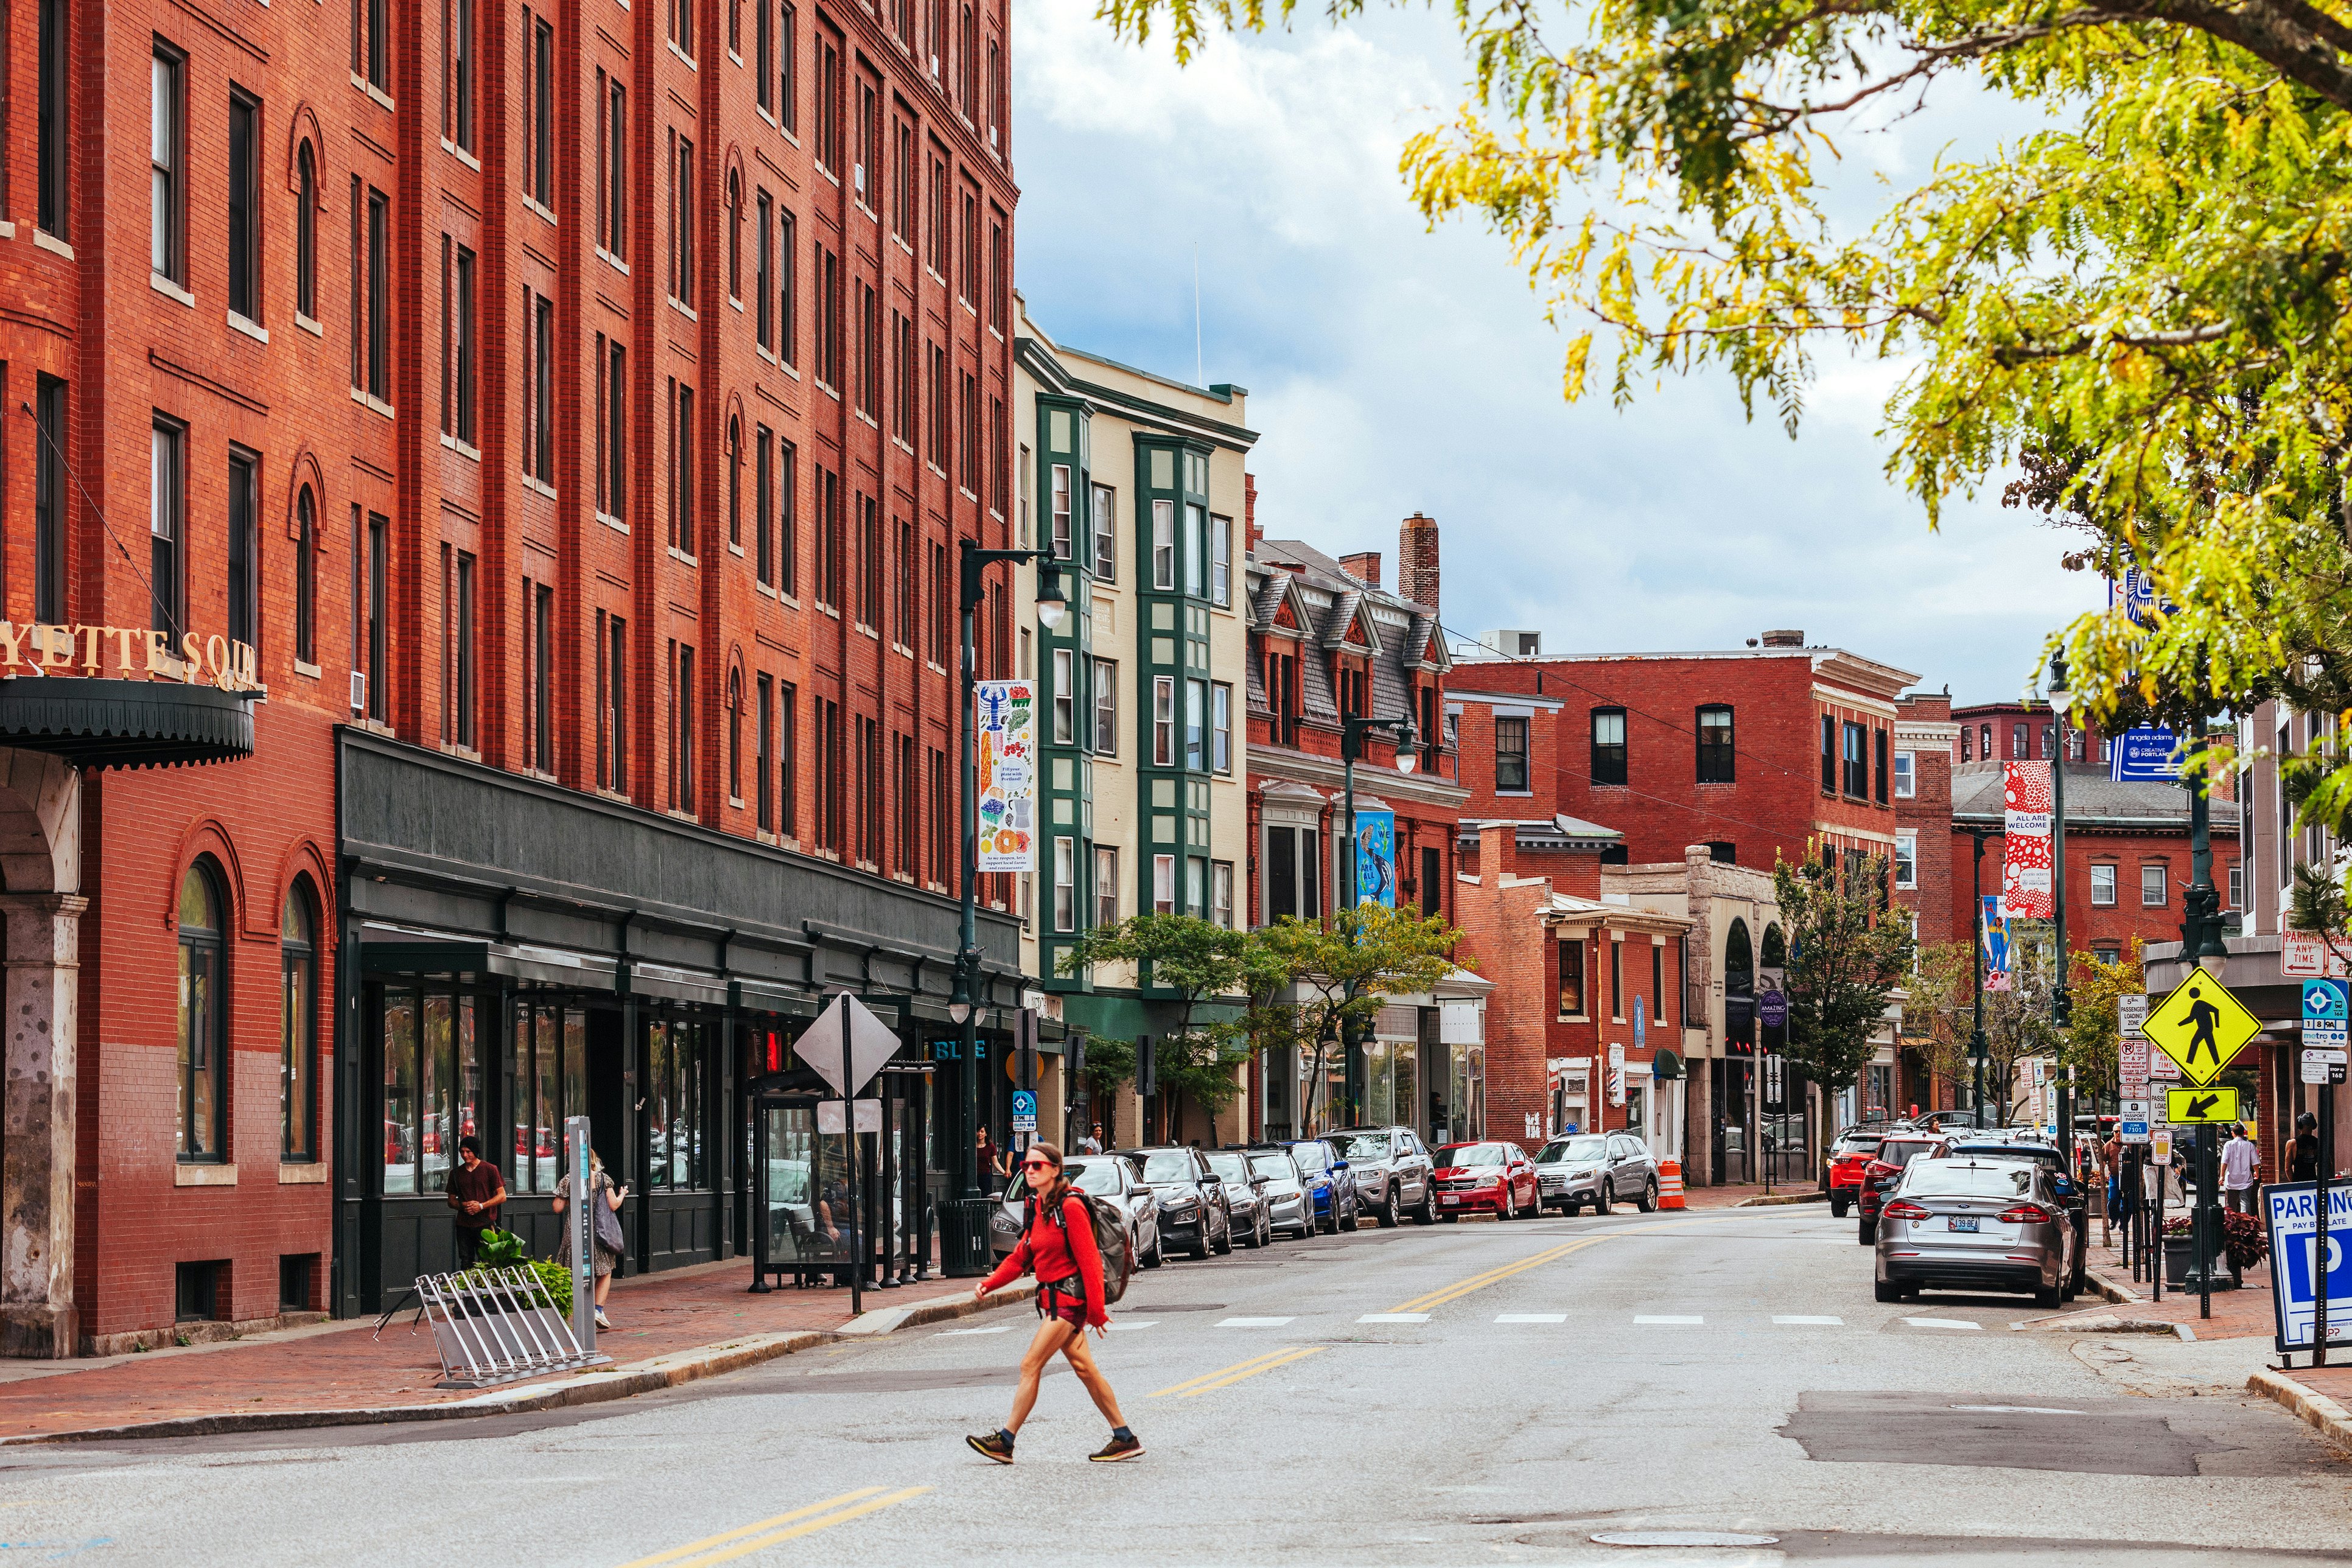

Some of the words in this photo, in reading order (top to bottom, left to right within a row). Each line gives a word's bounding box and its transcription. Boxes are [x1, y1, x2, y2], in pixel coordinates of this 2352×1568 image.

[1361, 864, 1373, 873] ARE
[2285, 931, 2324, 943] PARKING
[2296, 944, 2312, 953] ANY
[2294, 954, 2314, 963] TIME
[934, 1040, 985, 1059] BLE
[2273, 1191, 2352, 1219] PARIN
